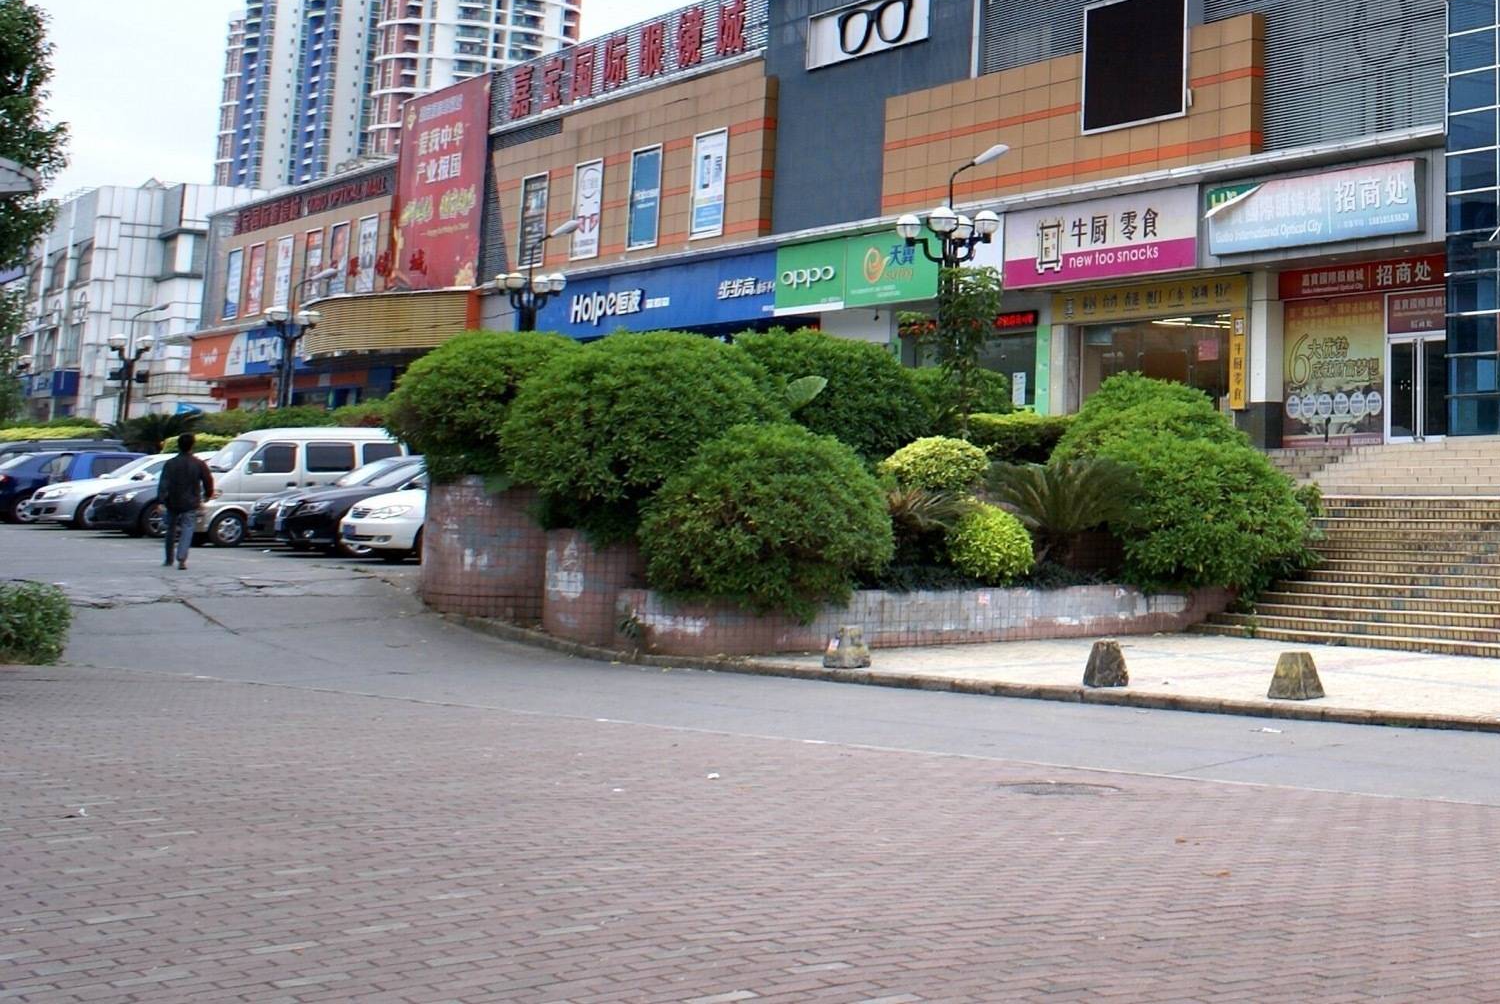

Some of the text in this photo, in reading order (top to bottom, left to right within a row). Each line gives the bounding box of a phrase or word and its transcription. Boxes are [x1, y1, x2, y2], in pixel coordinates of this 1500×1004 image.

[1334, 173, 1409, 214] 招商处
[1070, 207, 1159, 247] 牛厨 零食
[1069, 253, 1092, 268] new
[1117, 245, 1159, 262] snacks
[717, 277, 756, 300] 步步高
[1376, 260, 1432, 287] 招商处
[570, 291, 617, 327] Holpe
